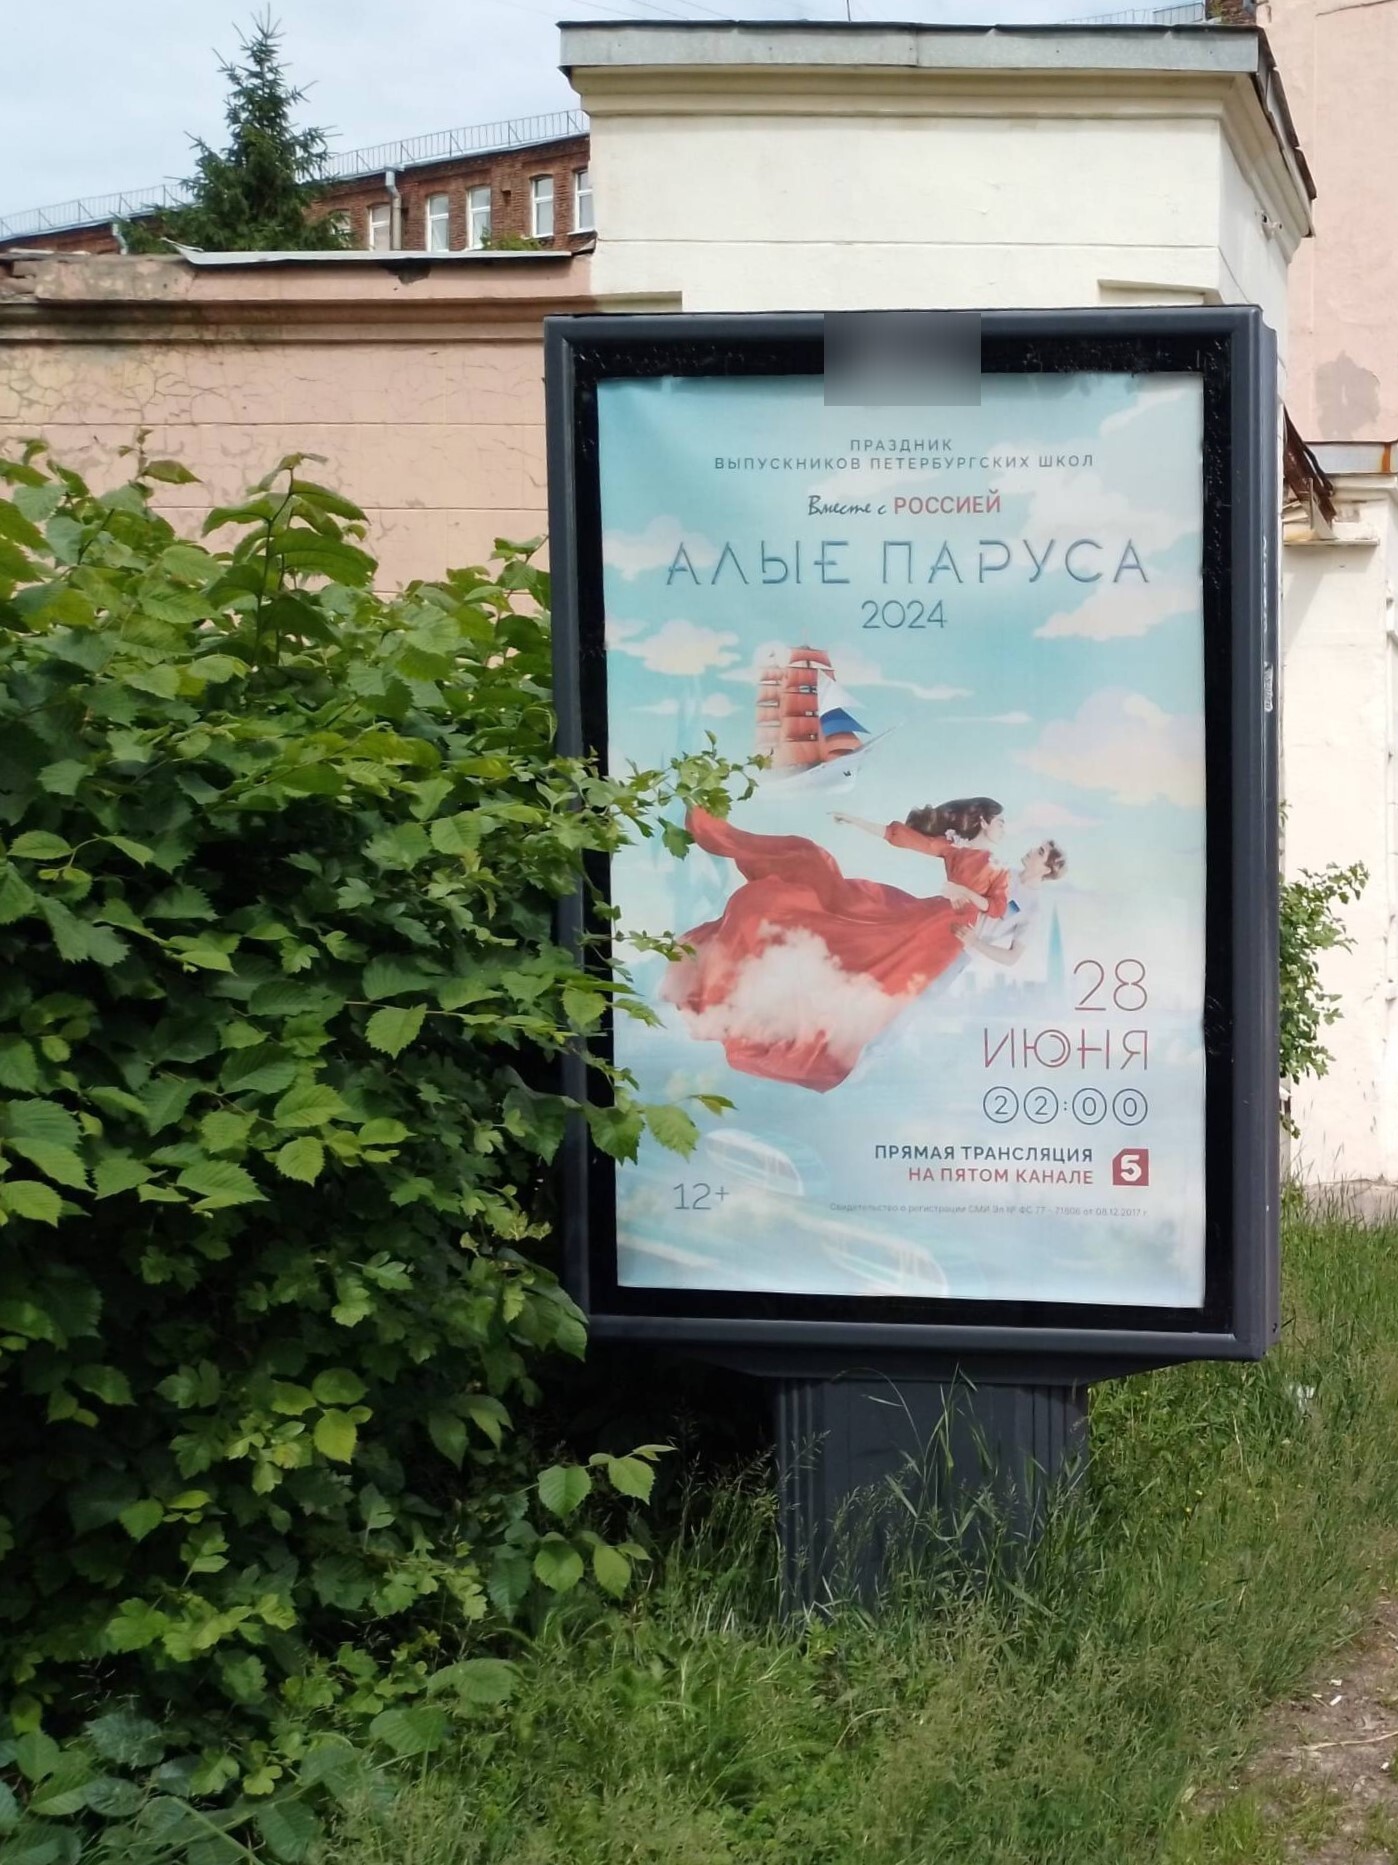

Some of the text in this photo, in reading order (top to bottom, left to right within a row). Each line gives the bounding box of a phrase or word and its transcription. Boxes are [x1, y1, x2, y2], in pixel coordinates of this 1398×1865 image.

[849, 438, 952, 453] ПРАЗДНИК
[714, 454, 1094, 470] ВЫПУСКНИКОВ ПЕТЕРБУРГСКИХ ШКОЛ
[807, 488, 1001, 516] Вместе с РОССИЕЙ
[666, 538, 1151, 586] АЛЫЕ ПАРУСА
[860, 599, 948, 629] 2024
[1073, 958, 1148, 1012] 28
[983, 1027, 1149, 1071] ИЮНЯ
[982, 1085, 1149, 1127] 22:00
[874, 1144, 1093, 1165] ПРЯМАЯ ТРАНСЛЯЦИЯ
[1120, 1154, 1143, 1183] 5
[908, 1167, 1094, 1185] НА ПЯТОМ КАНАЛЕ
[672, 1182, 731, 1211] 12+
